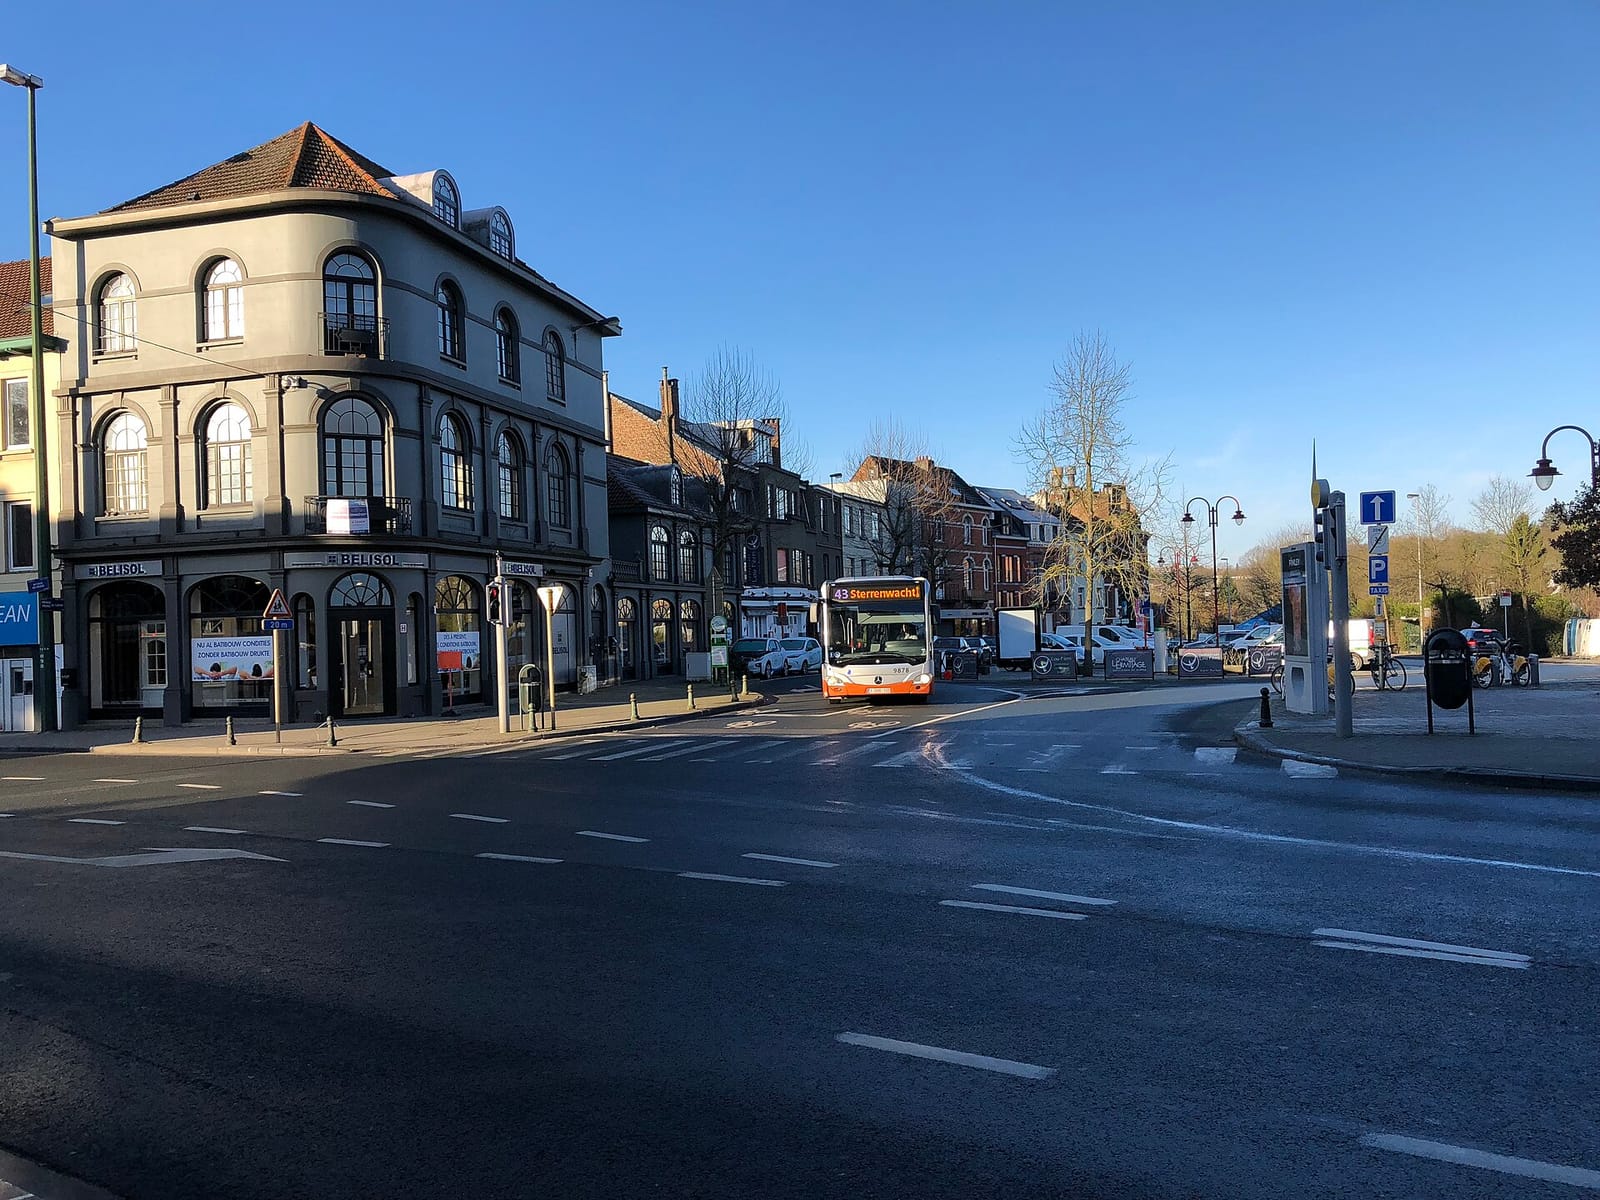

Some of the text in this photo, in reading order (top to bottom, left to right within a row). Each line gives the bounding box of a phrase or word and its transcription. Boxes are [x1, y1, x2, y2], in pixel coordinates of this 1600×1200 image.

[341, 553, 399, 566] BELISOL
[99, 563, 145, 577] BELISOL
[1371, 559, 1385, 579] P
[834, 589, 849, 599] 43
